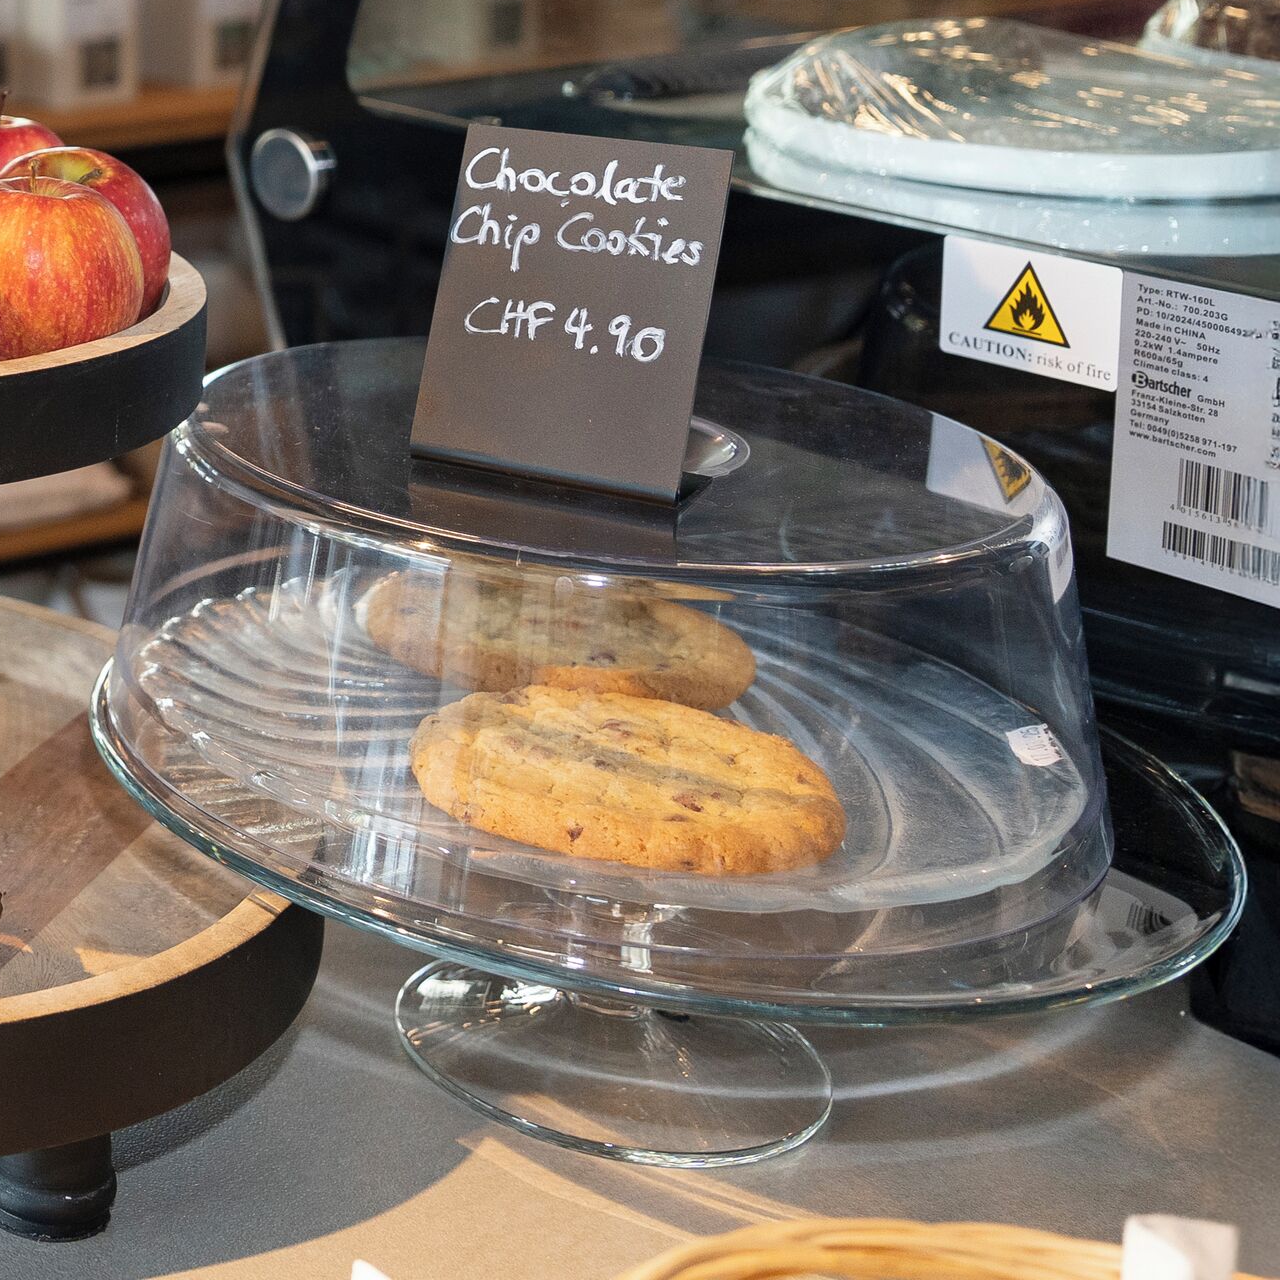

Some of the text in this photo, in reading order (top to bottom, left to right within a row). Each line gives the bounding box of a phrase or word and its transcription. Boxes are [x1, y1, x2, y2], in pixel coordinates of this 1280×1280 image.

[465, 147, 686, 206] Chocolate
[450, 203, 703, 272] Chip Cookies
[1137, 296, 1228, 321] Art.-No.: 700.203G
[1138, 284, 1216, 307] Type: RTW-160L
[1136, 307, 1153, 317] PD:
[464, 297, 666, 362] CHF 4.90
[1135, 329, 1172, 344] 220-240
[1196, 343, 1221, 355] 50Hz
[1136, 318, 1206, 340] Made in CHINA
[948, 331, 1112, 381] CAUTION: risk of fire
[1134, 339, 1218, 365] 0.2kW 1.4ampere
[1134, 349, 1184, 368] R600a/65g
[1133, 359, 1169, 374] Climate
[1171, 369, 1200, 381] class:
[1131, 370, 1225, 408] Bartscher GmbH
[1131, 389, 1219, 417] Franz-Kleine-Str. 28
[1131, 399, 1206, 423] 33154 Salzkotten
[1130, 408, 1170, 426] Germany
[1129, 419, 1238, 453] Tel: 0049(0)5258 971-197
[1129, 430, 1217, 458] www.bartscher.com
